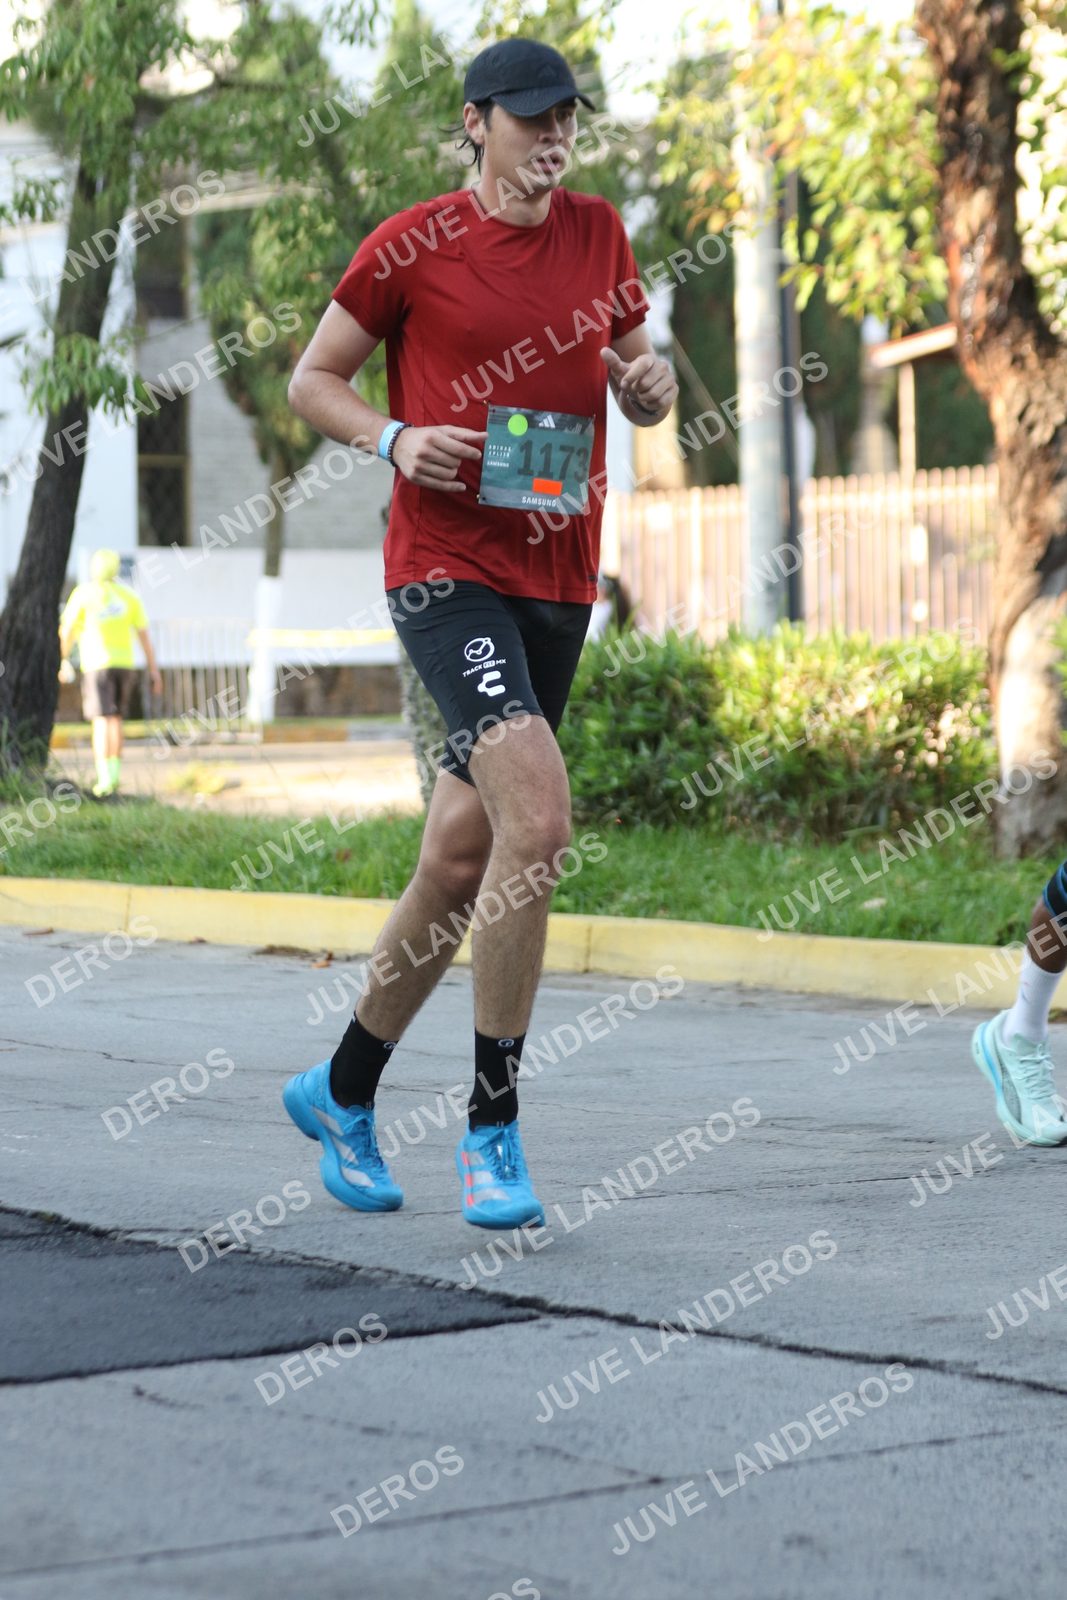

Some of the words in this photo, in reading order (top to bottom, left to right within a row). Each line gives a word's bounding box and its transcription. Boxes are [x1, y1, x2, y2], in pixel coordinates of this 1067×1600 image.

[517, 439, 589, 483] 1173
[521, 495, 557, 507] SAMSUNG
[462, 664, 483, 677] TRACK
